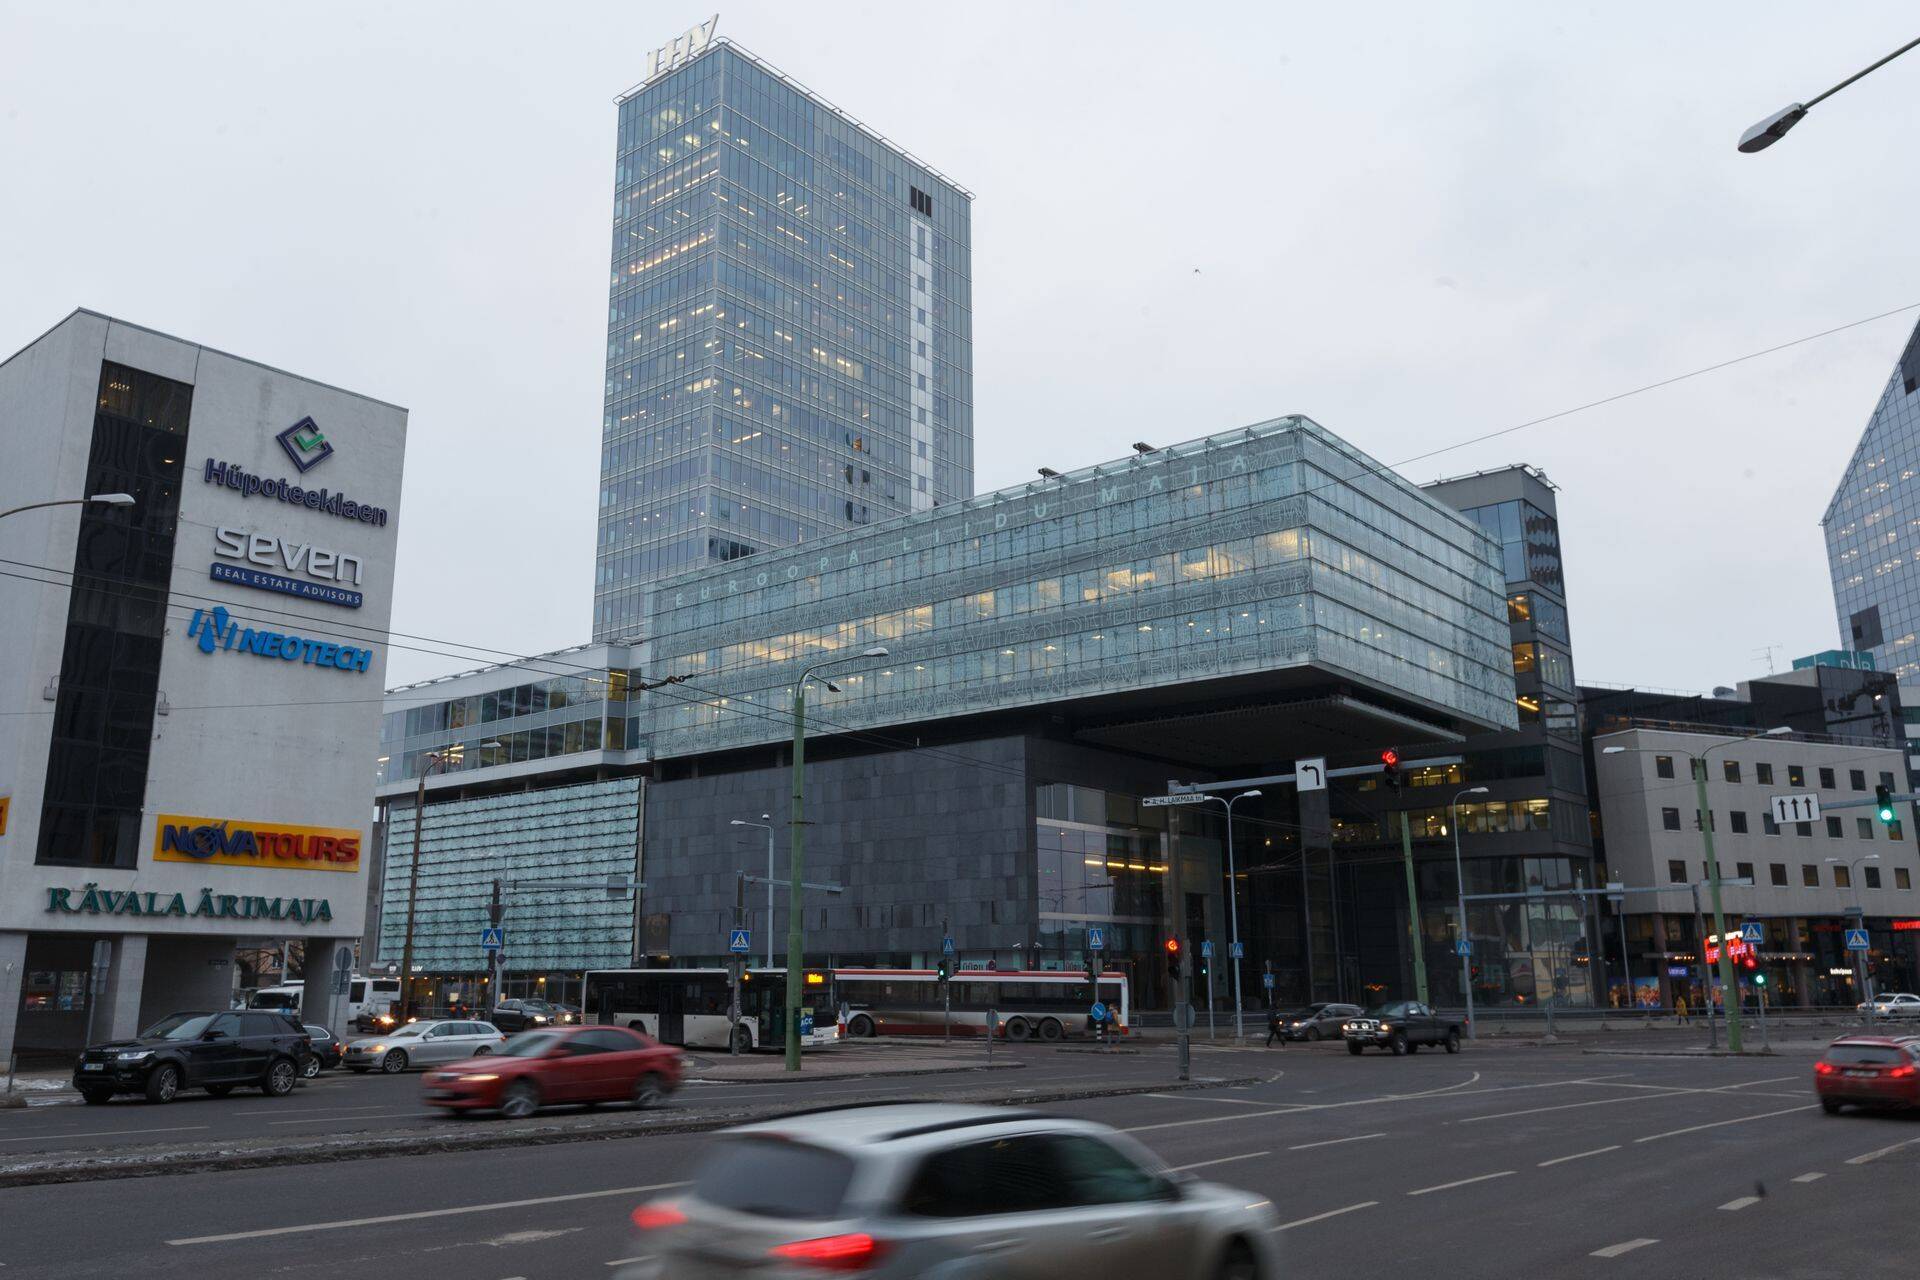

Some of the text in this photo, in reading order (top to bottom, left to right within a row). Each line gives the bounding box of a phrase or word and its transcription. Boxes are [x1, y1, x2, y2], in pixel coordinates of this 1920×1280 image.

[205, 457, 388, 527] Hüpoteeklaen
[675, 455, 1245, 607] EUROOPA LIIDU MAJA
[215, 566, 361, 605] REAL ESTATE ADVISORS
[239, 626, 373, 672] NEOTECH
[45, 882, 334, 926] RÄVALA ÄRIMAJA
